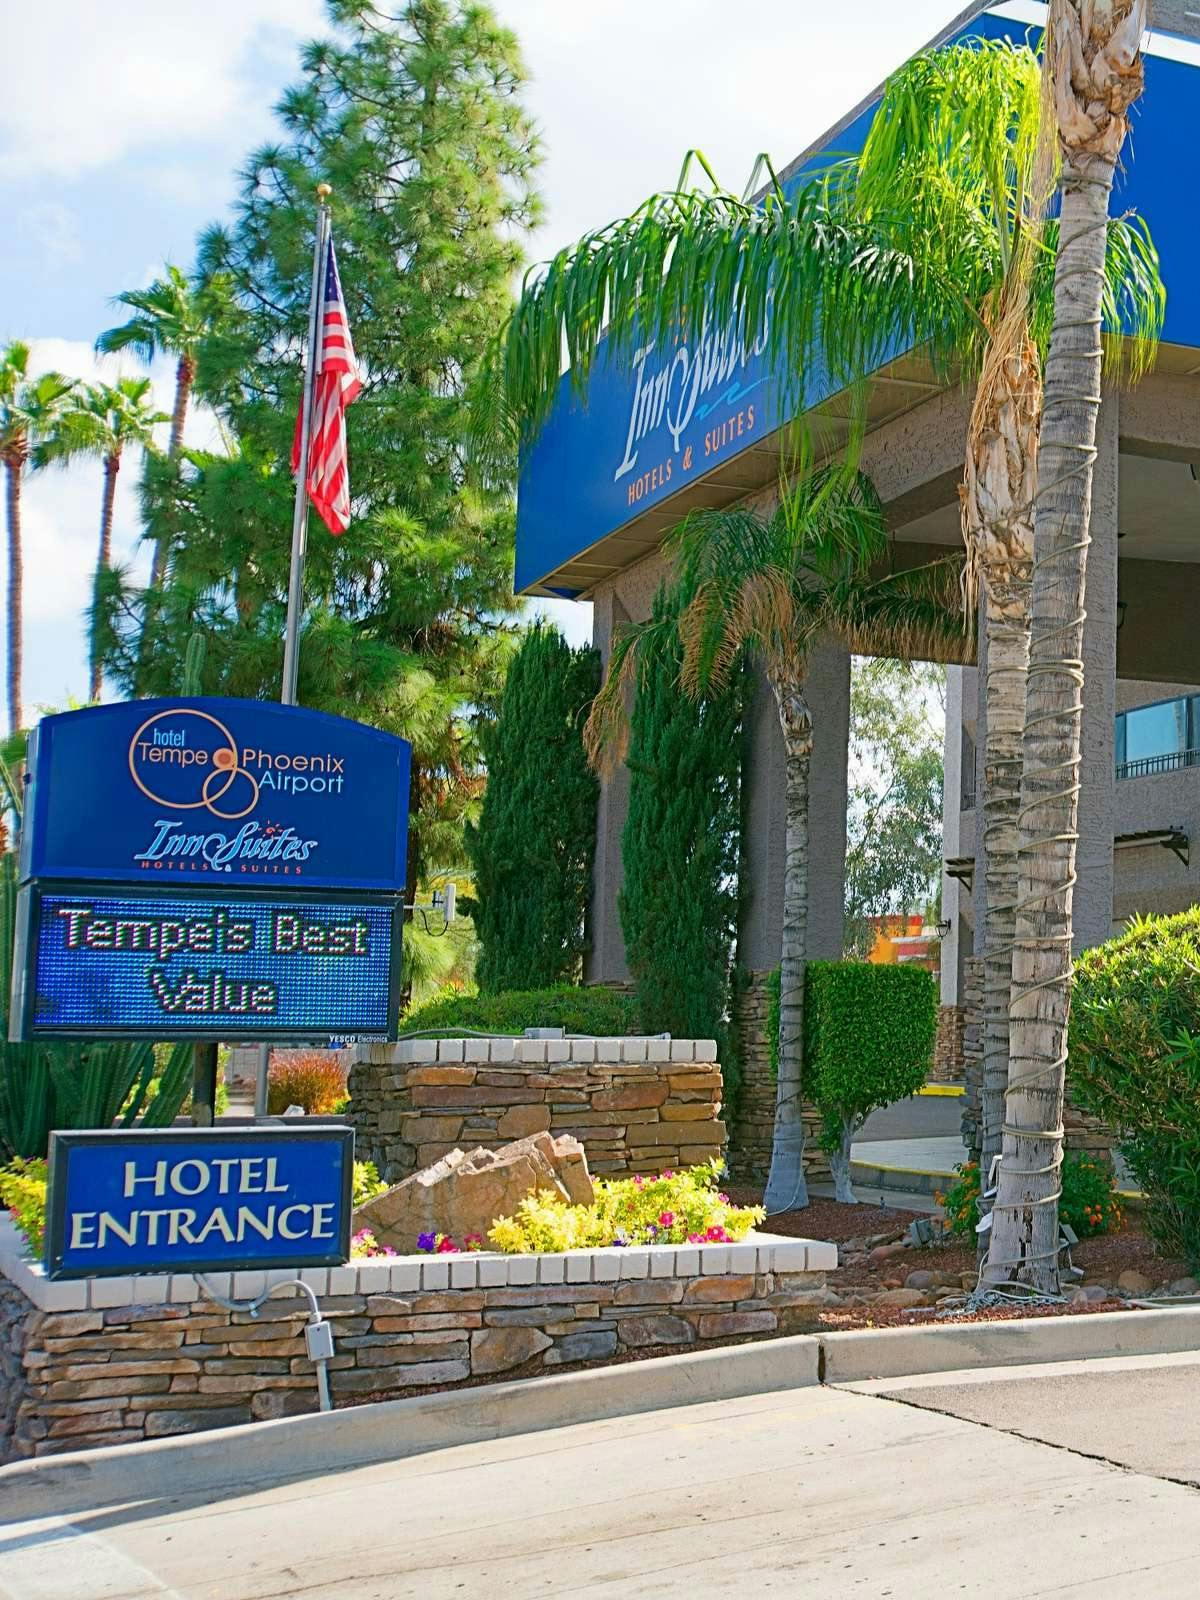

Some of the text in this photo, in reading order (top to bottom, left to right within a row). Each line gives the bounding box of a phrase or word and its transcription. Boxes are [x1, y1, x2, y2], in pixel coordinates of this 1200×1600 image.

[628, 404, 755, 505] HOTELS & SUITES
[153, 728, 185, 747] hotel
[138, 742, 345, 773] Tempe Phoenix
[258, 770, 344, 795] Airport
[141, 860, 208, 872] HOTELS
[240, 863, 302, 875] SUITES
[59, 908, 370, 960] Tempe's Best
[150, 969, 278, 1013] Value
[329, 1035, 356, 1043] YESCO
[123, 1157, 289, 1198] HOTEL
[69, 1203, 336, 1250] ENTRANCE
